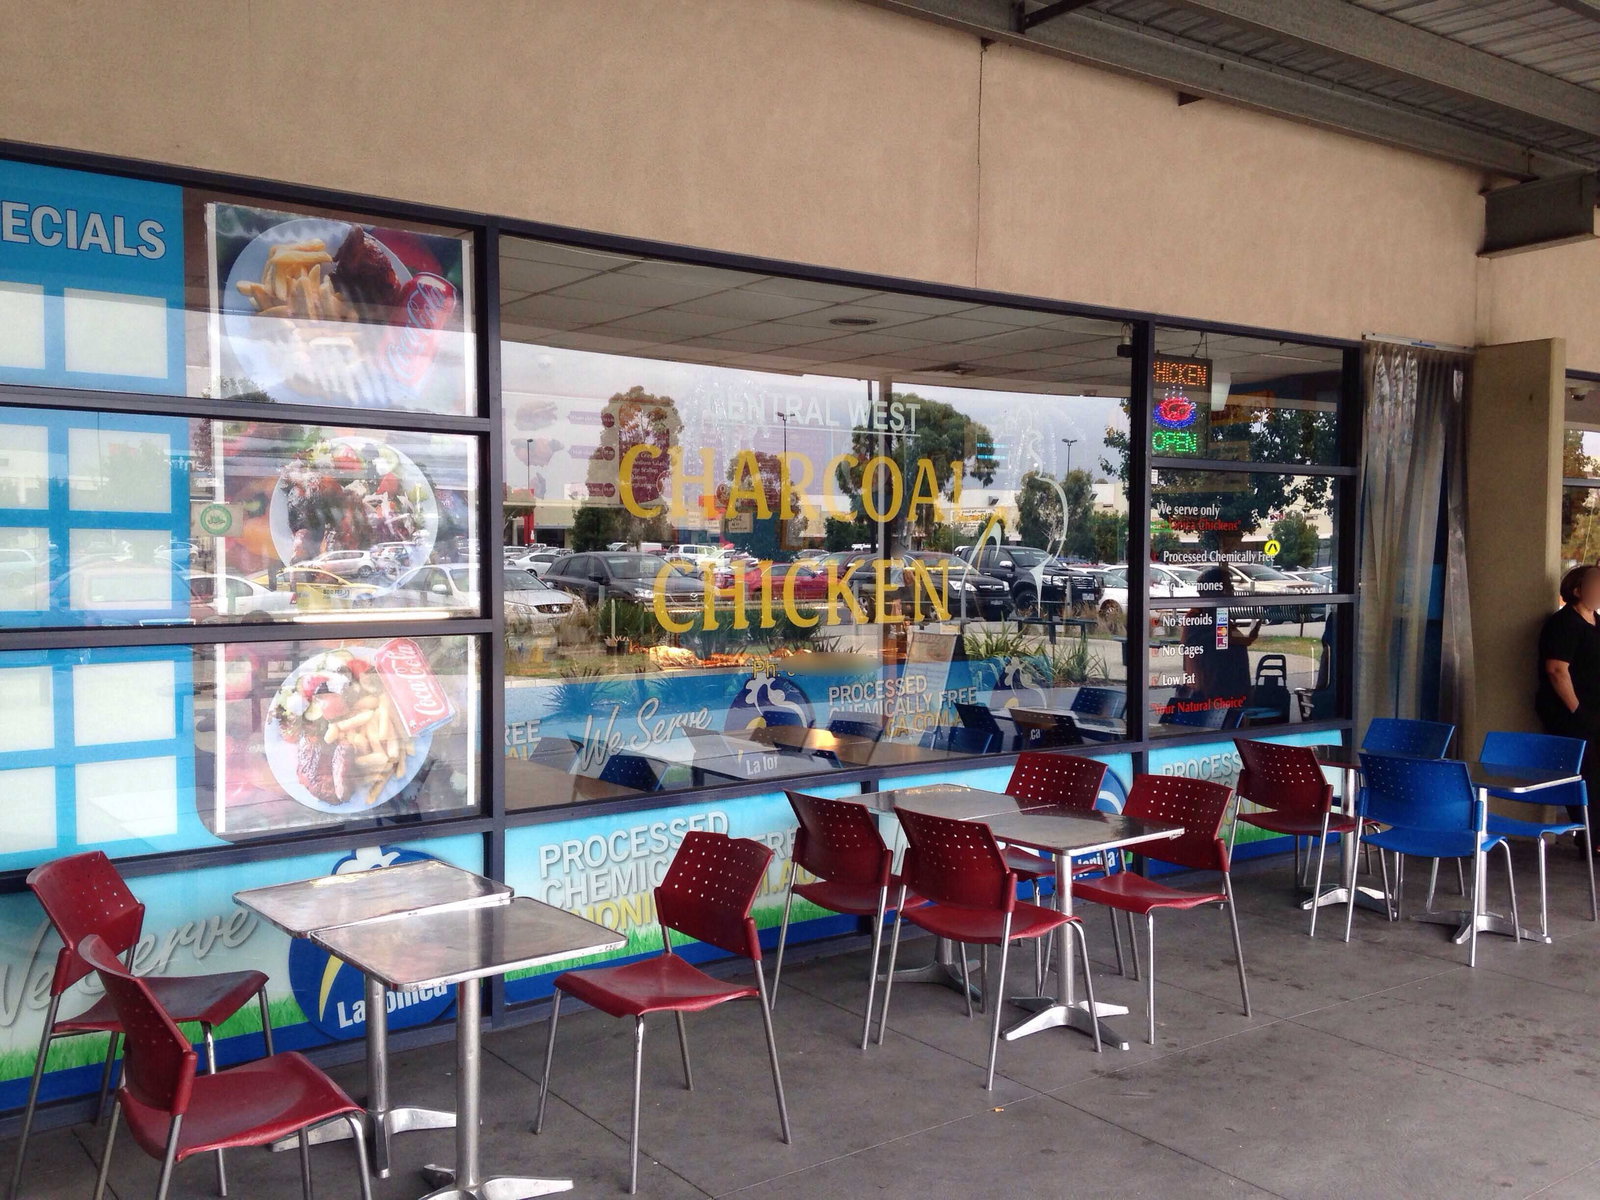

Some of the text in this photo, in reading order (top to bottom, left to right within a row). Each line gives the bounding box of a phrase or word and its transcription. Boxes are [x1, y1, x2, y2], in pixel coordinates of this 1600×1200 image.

[1152, 361, 1207, 386] HICKEN
[848, 399, 921, 433] WEST
[1152, 431, 1197, 453] OPEN
[1157, 502, 1220, 519] We serve only
[1163, 550, 1275, 564] Processed Chemically Free
[653, 559, 952, 634] CHICKEN
[1162, 613, 1213, 627] No steroids
[1162, 644, 1204, 658] No Cages
[828, 674, 927, 706] PROCESSED
[1162, 673, 1195, 686] Low Fat
[941, 686, 977, 708] FREE
[1177, 698, 1211, 712] Natural
[579, 697, 712, 771] We Serve
[1161, 751, 1242, 781] PROCESS
[542, 857, 668, 909] CHEMIC
[337, 1000, 366, 1029] La
